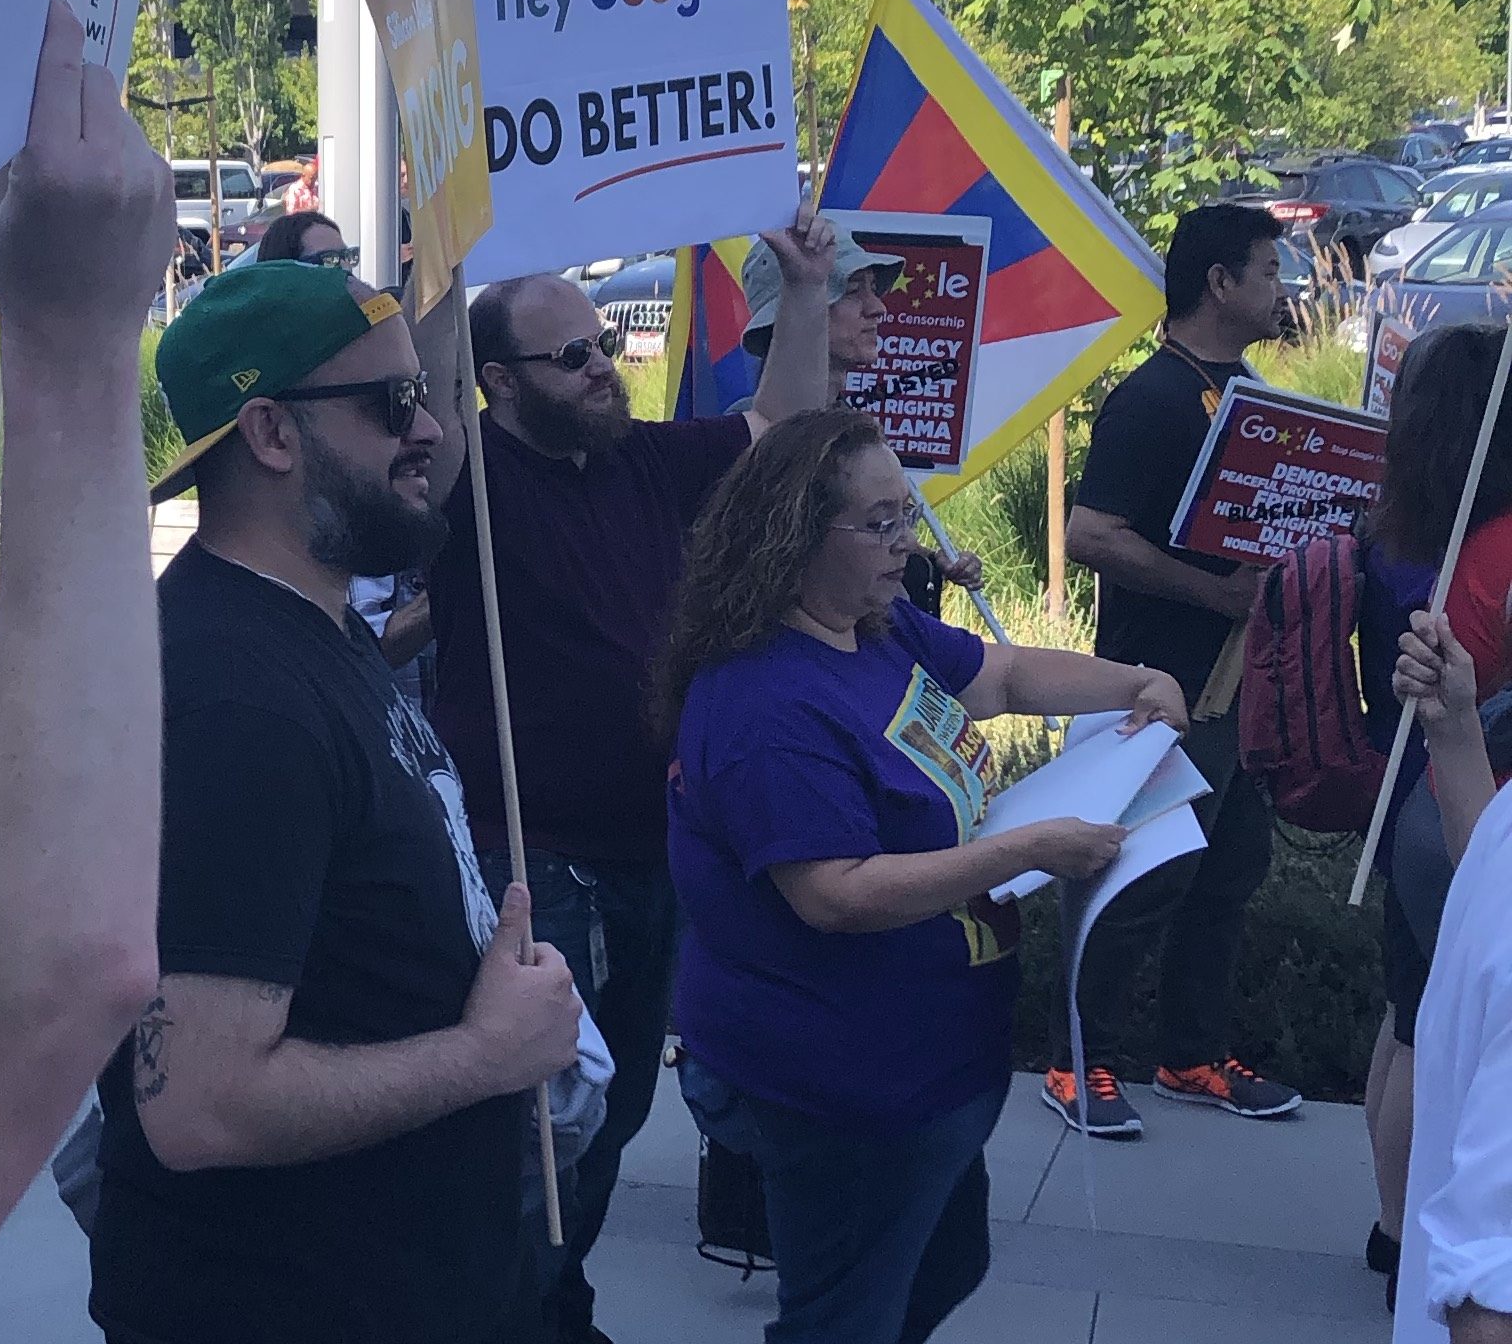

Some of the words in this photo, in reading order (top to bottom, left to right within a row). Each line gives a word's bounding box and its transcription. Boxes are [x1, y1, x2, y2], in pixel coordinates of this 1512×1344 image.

[483, 98, 562, 174] DO
[578, 64, 777, 157] BETTER!
[897, 312, 966, 330] Censorship
[884, 399, 956, 419] RIGHTS
[884, 417, 952, 441] LAMA
[907, 441, 951, 456] PRIZE
[1219, 468, 1278, 492] PEACEFUL
[1281, 483, 1336, 502] PROTEST
[1222, 535, 1261, 555] NOBEL
